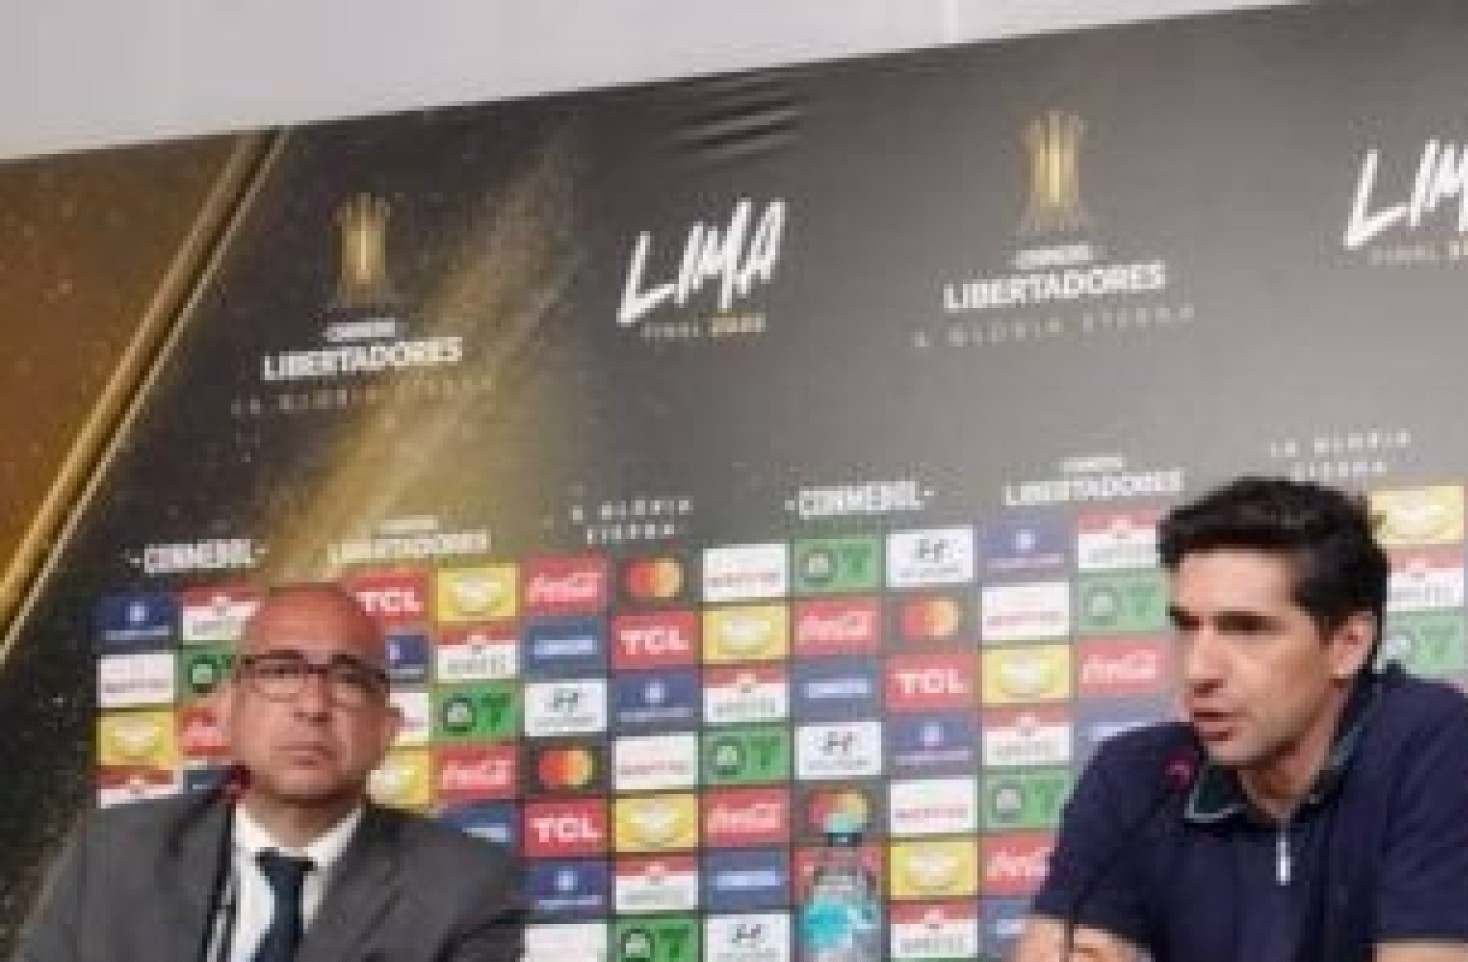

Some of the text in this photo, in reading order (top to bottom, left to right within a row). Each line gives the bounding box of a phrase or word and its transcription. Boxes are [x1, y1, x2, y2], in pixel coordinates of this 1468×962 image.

[616, 197, 786, 326] LIMA
[943, 260, 1167, 311] LIBERTADORES
[263, 336, 463, 382] LIBERTADORES
[359, 587, 423, 614] TCL
[619, 625, 690, 656] TCL
[897, 668, 968, 699] TCL
[532, 816, 603, 844] TCL
